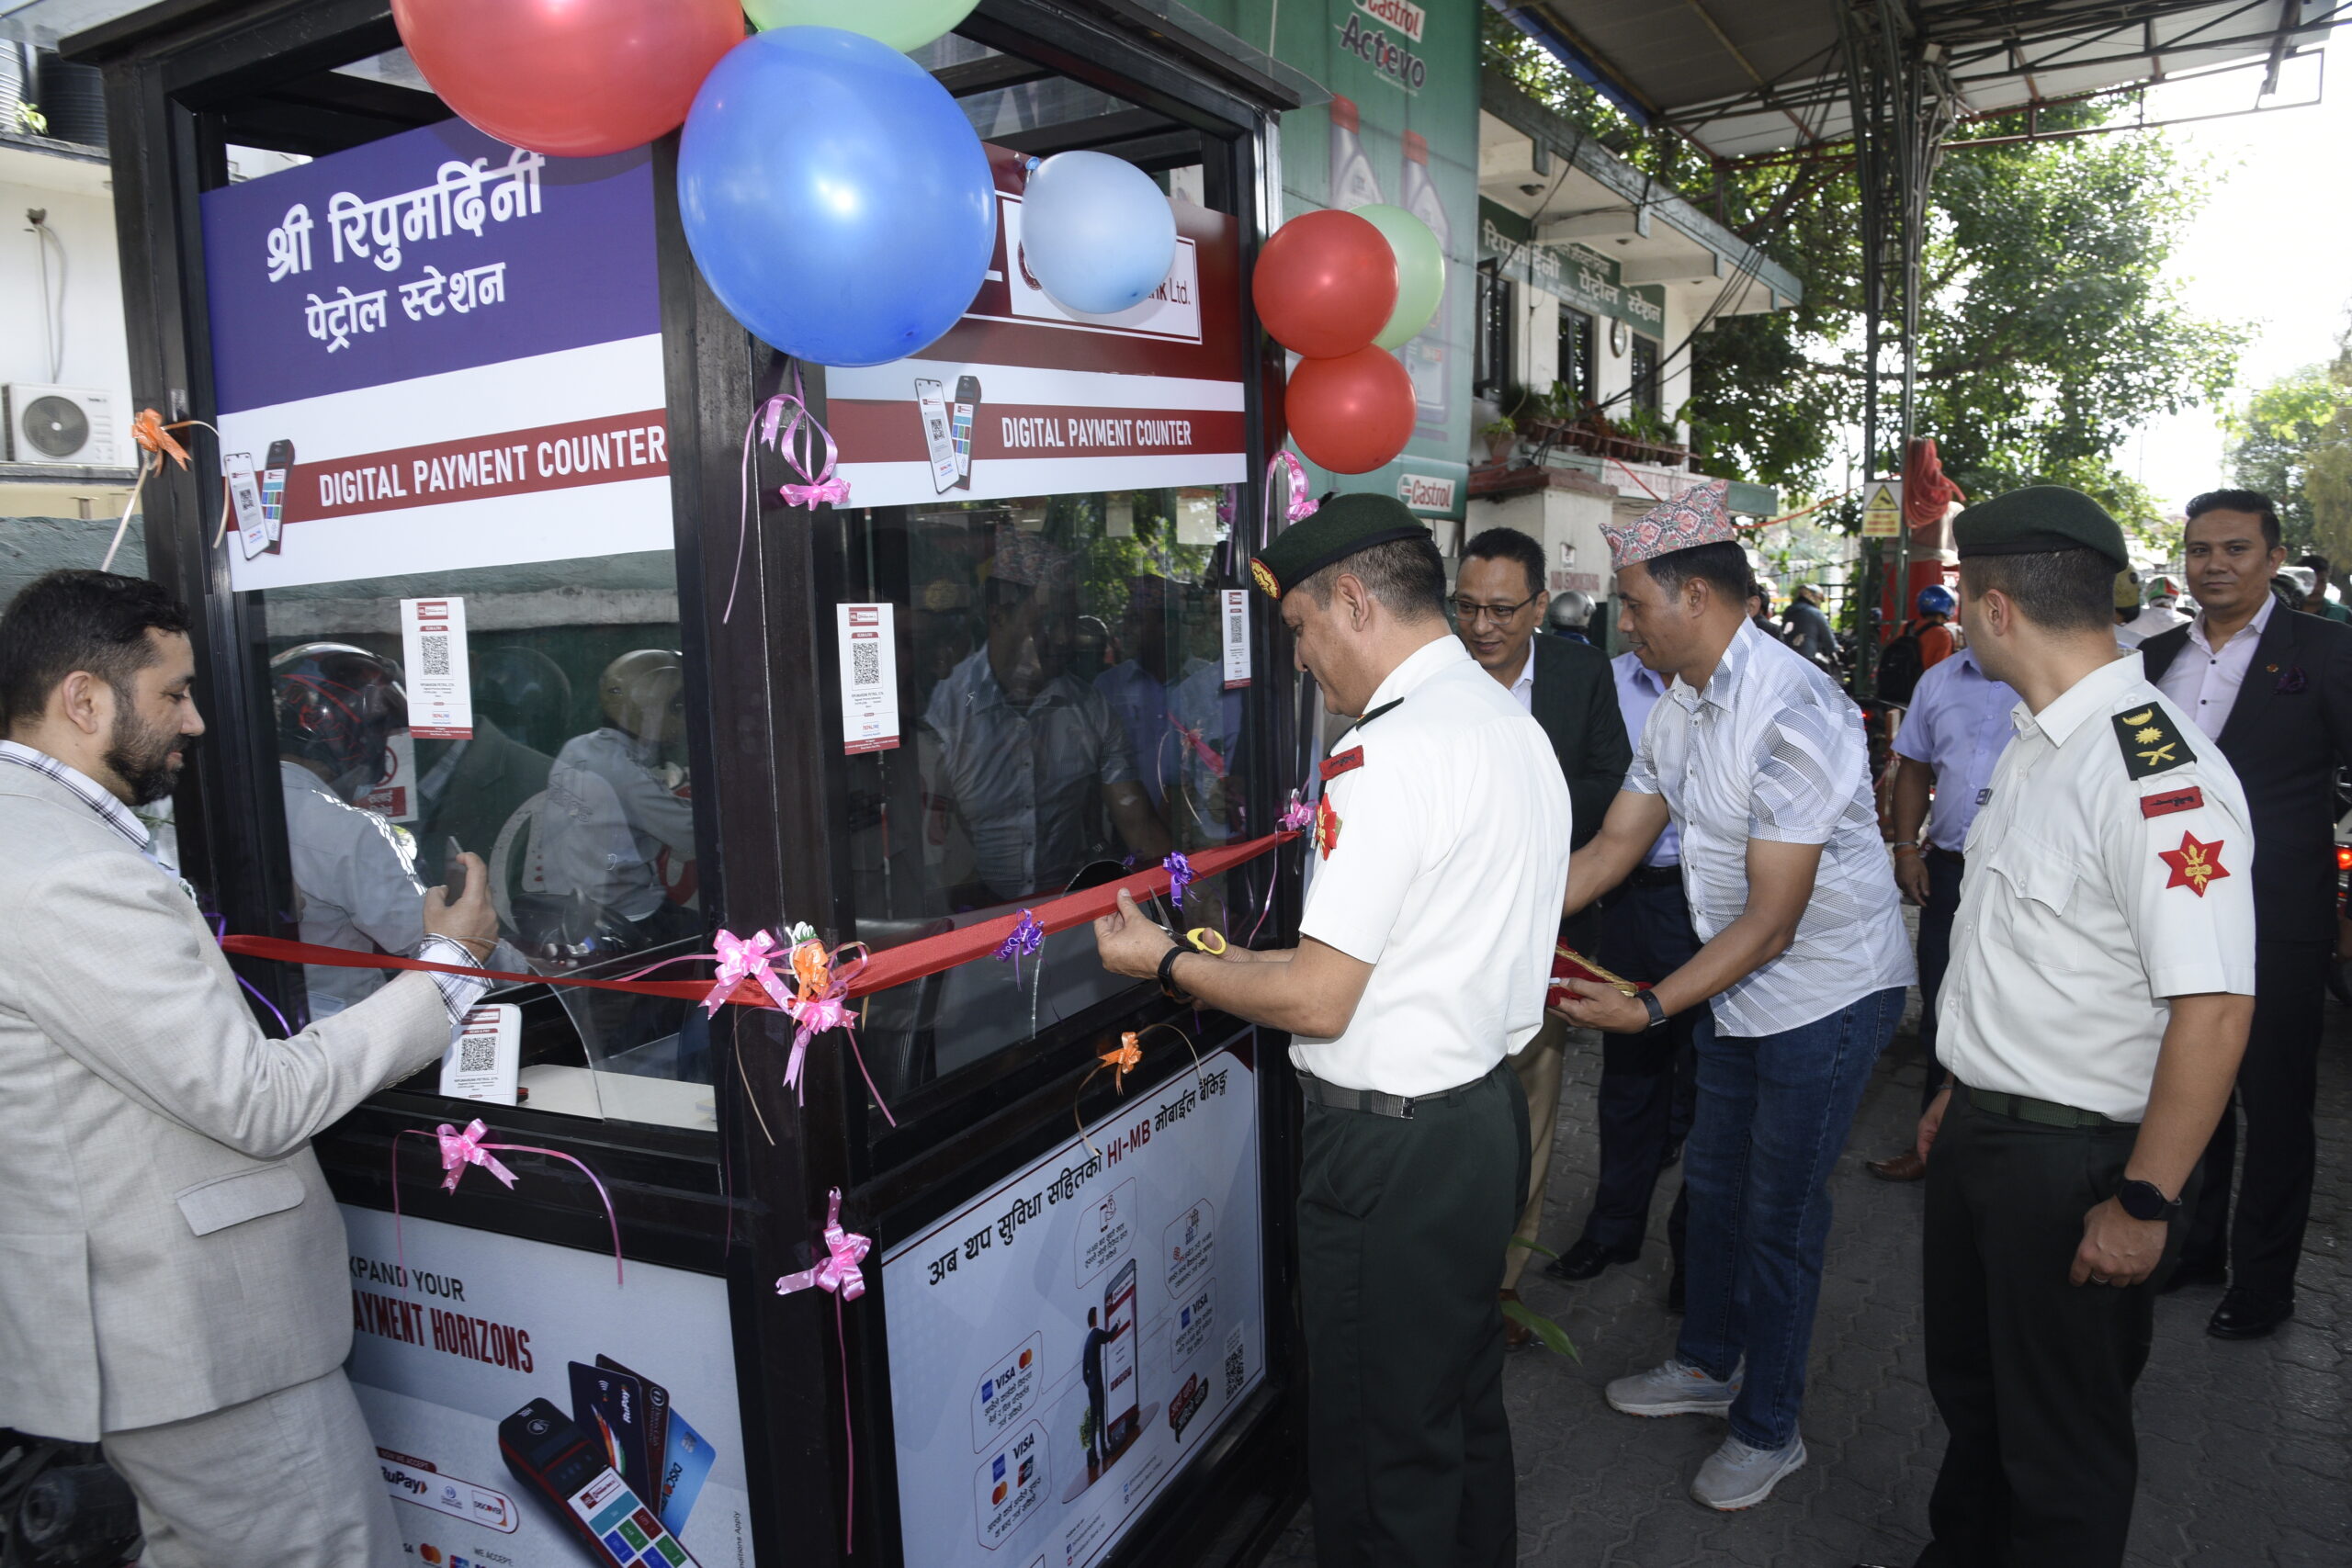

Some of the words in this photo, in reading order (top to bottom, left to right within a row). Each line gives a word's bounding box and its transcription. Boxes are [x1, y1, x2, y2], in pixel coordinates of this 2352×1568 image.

[1334, 12, 1426, 88] Actevo
[266, 204, 313, 281] श्री
[327, 149, 546, 272] रिपुमर्दिनी
[305, 287, 388, 353] पेट्रोल
[399, 262, 507, 321] स्टेशन
[1170, 276, 1191, 305] Ltd.
[1001, 416, 1065, 448] DIGITAL
[1069, 418, 1132, 447] PAYMENT
[1136, 419, 1193, 446] COUNTER
[319, 464, 406, 507] DIGITAL
[413, 445, 528, 494] PAYMENT
[537, 424, 667, 478] COUNTER
[1412, 479, 1452, 508] Castrol
[928, 1247, 959, 1286] अब
[964, 1225, 992, 1260] थप
[998, 1191, 1043, 1247] सुविधा
[1107, 1119, 1150, 1168] HI-MB
[1155, 1089, 1196, 1132] मोबाईल
[349, 1256, 408, 1288] XPAND
[412, 1269, 466, 1302] YOUR
[1193, 1292, 1209, 1315] VISA
[352, 1289, 424, 1347] AYMENT
[430, 1307, 534, 1374] HORIZONS
[995, 1366, 1016, 1390] VISA
[1012, 1433, 1035, 1460] VISA
[733, 1511, 742, 1535] Apply
